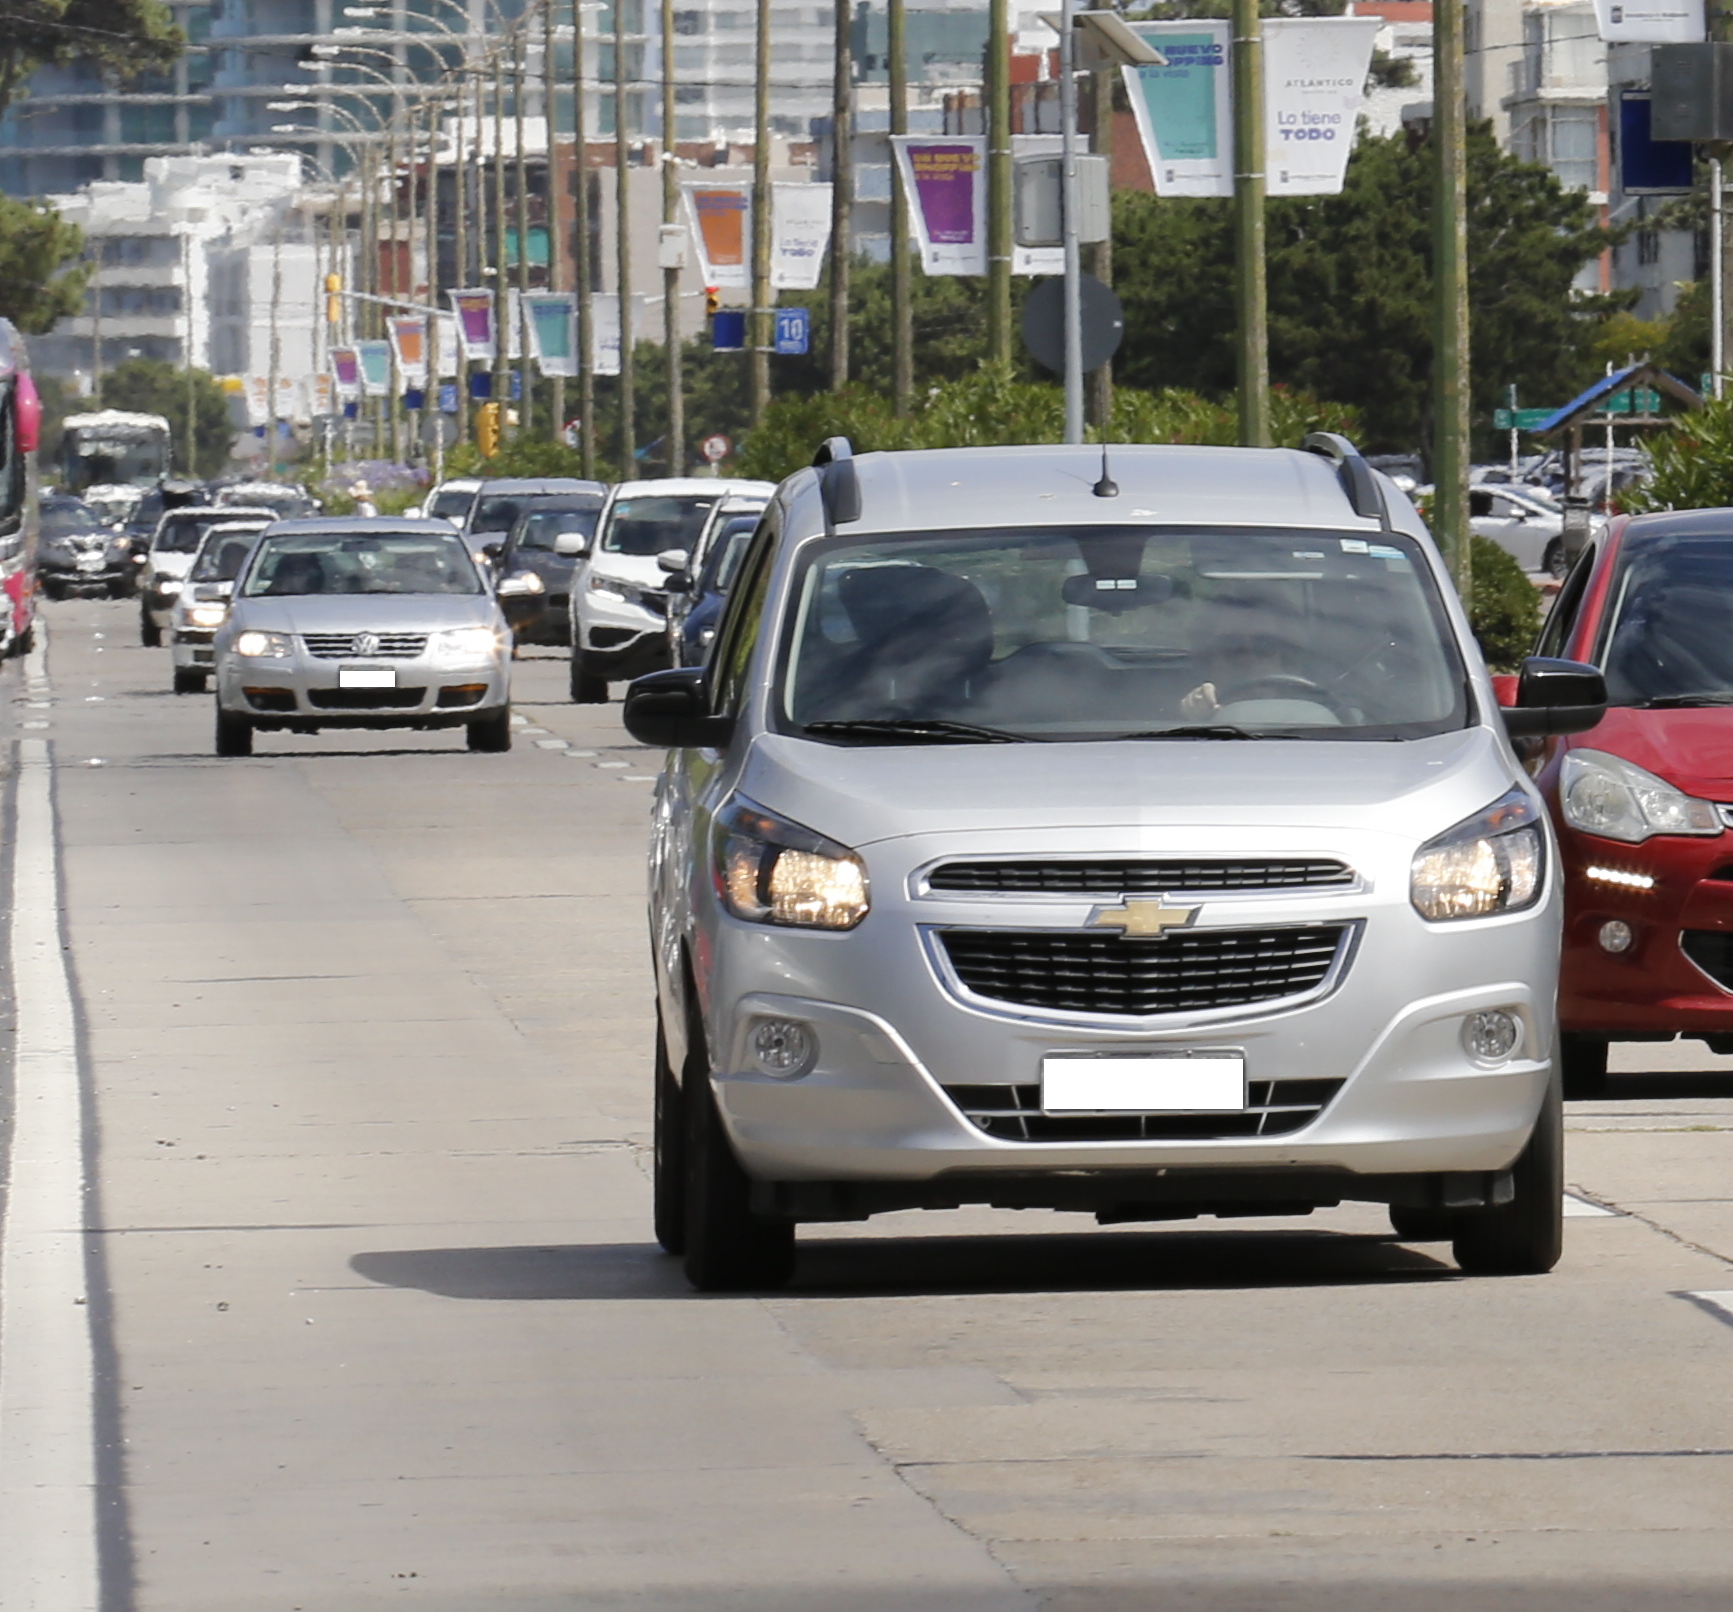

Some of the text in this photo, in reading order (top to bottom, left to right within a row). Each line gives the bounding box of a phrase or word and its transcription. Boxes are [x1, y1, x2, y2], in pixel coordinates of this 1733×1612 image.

[1277, 109, 1341, 125] Lo tiene
[1279, 128, 1336, 141] TODO
[780, 318, 803, 340] 10
